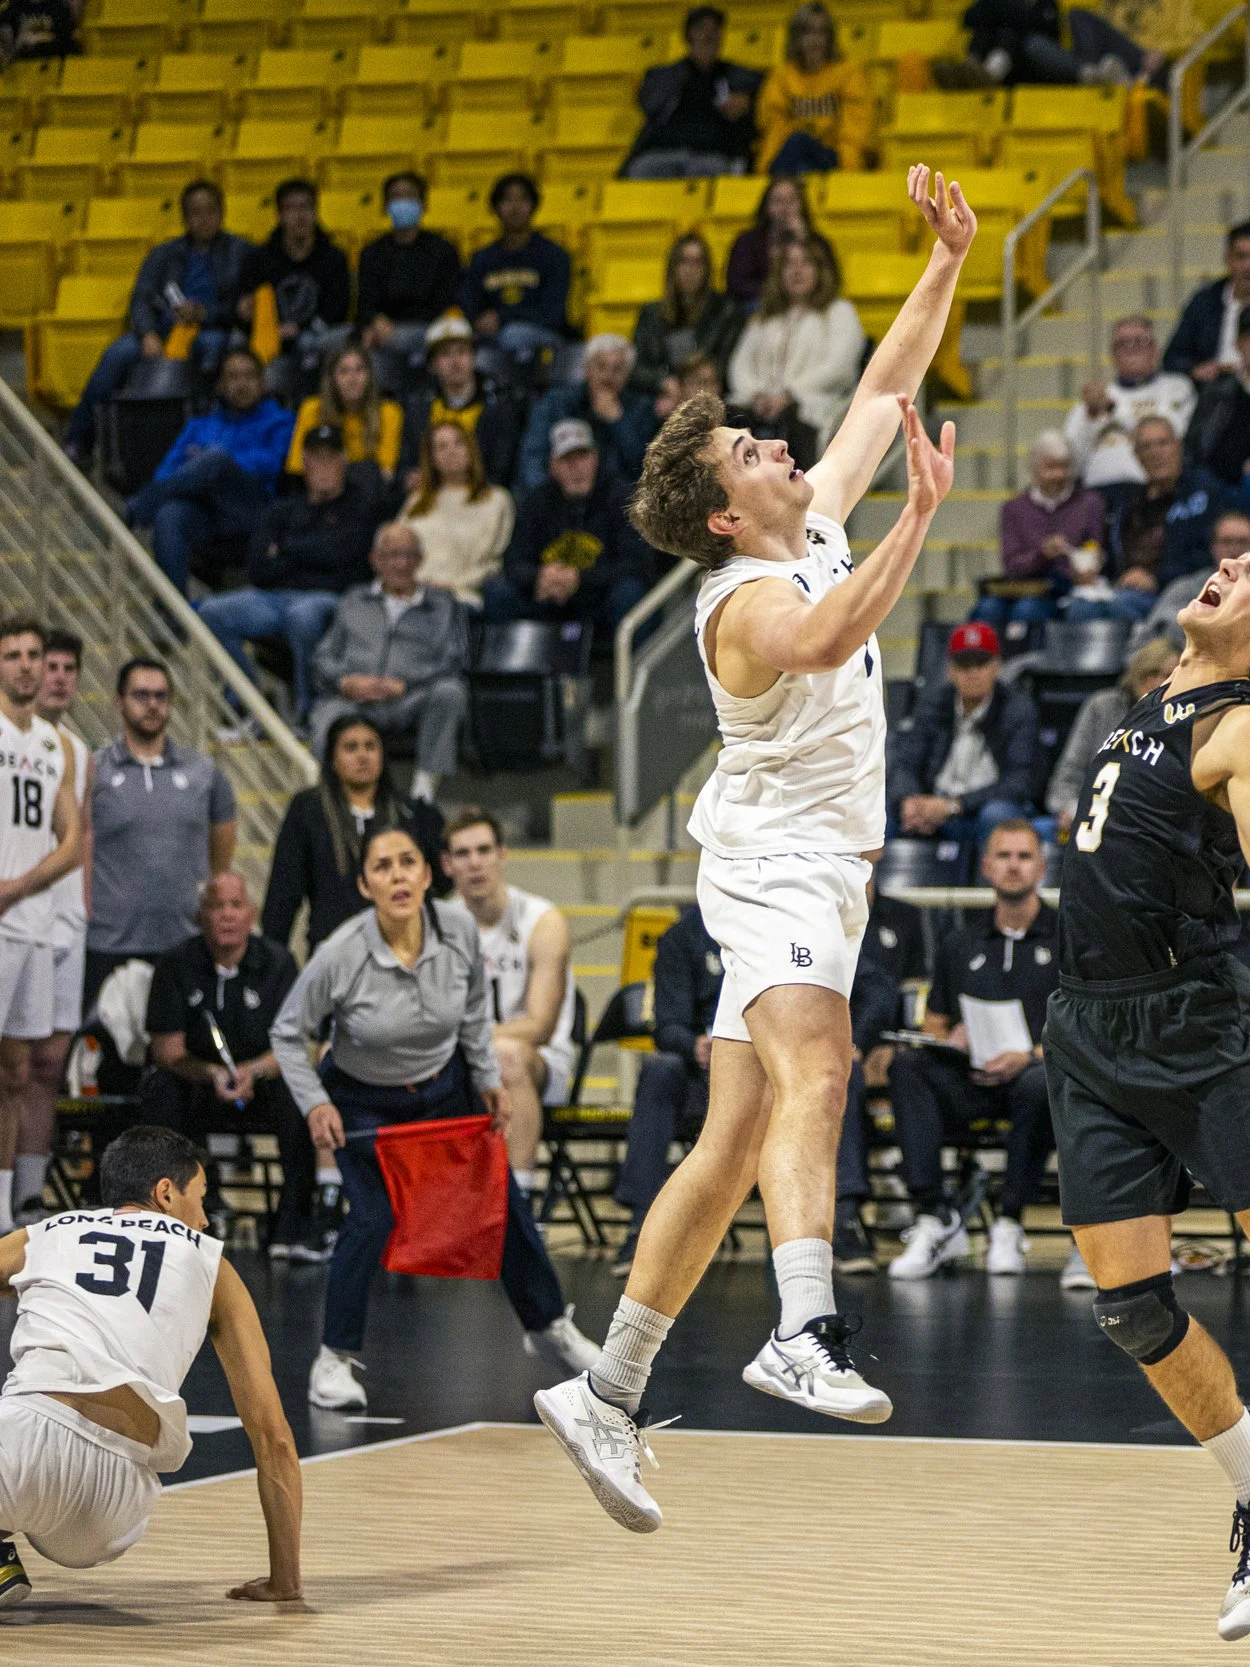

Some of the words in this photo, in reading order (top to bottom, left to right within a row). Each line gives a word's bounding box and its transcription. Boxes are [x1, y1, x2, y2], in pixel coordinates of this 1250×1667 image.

[1098, 728, 1165, 766] EACH
[12, 775, 43, 828] 18
[1076, 761, 1121, 853] 3
[75, 1231, 167, 1315] 31
